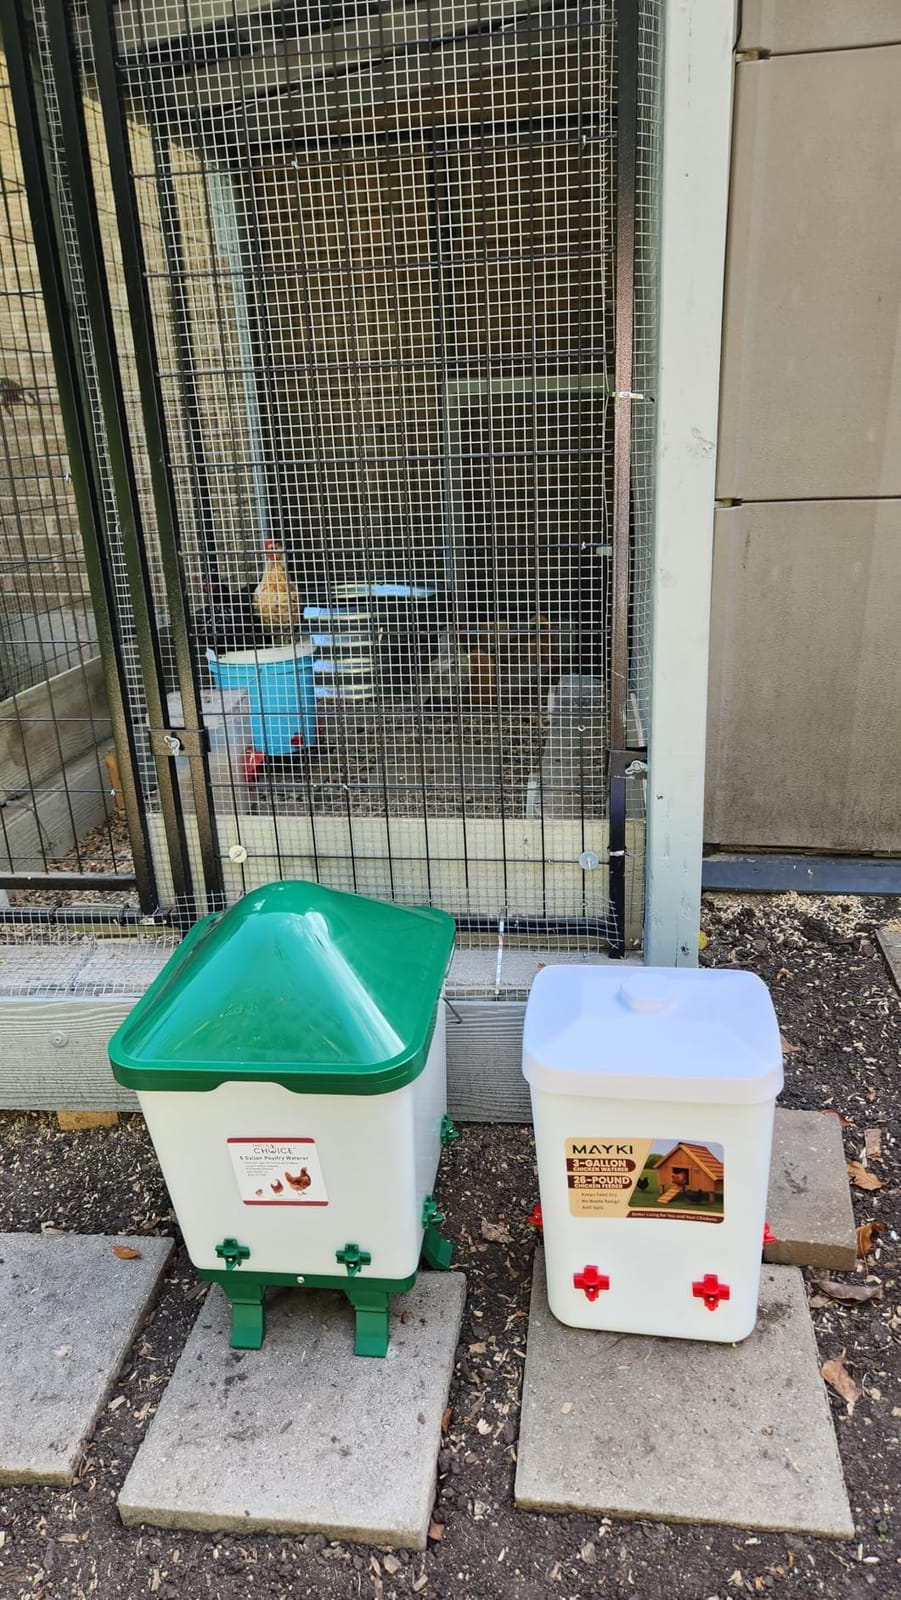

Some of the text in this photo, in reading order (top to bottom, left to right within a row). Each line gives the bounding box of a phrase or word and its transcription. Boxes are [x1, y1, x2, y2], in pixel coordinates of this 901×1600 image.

[572, 1144, 633, 1155] MAYKI
[572, 1159, 627, 1168] 3-GALLON
[573, 1176, 630, 1185] 26-POUND
